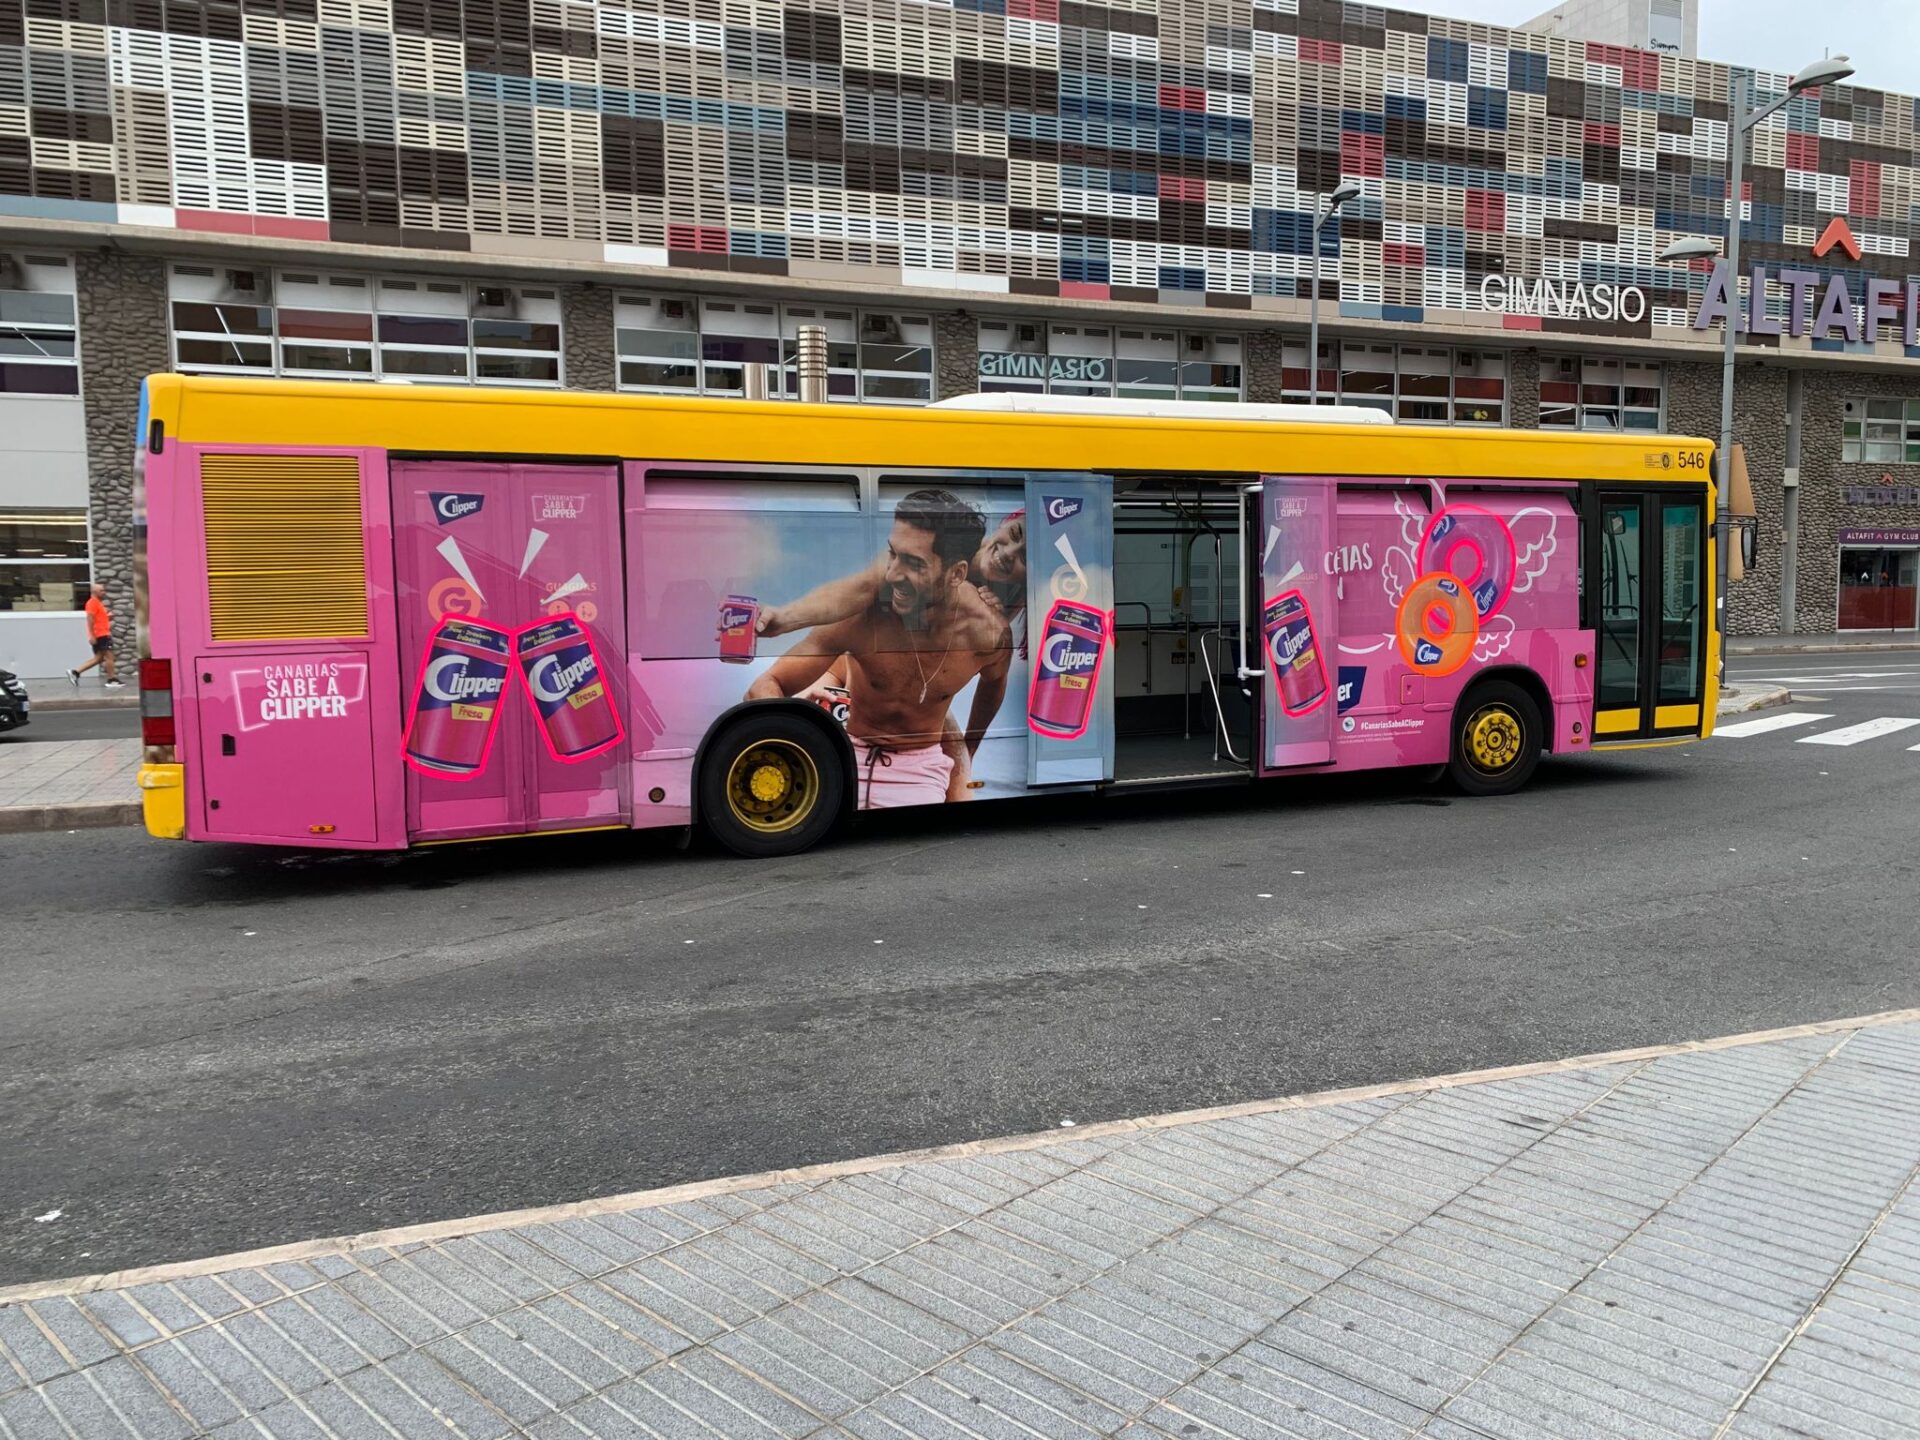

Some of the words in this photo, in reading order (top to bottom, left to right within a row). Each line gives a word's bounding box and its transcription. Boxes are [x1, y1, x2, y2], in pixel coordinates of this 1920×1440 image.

[1480, 274, 1646, 323] GIMNASIO
[979, 353, 1105, 381] GIMNASIO
[1678, 450, 1705, 470] 546
[438, 495, 479, 518] Clipper
[542, 509, 577, 519] CLIPPER
[1049, 498, 1079, 519] Clipper
[1846, 532, 1874, 540] ALTAFIT
[1042, 633, 1098, 673] Clipper
[1271, 625, 1311, 666] Clipper
[264, 663, 340, 680] CANARIAS
[423, 654, 506, 702] Clipper
[528, 654, 596, 702] Clipper
[266, 677, 317, 698] SABE
[326, 676, 339, 695] A
[574, 688, 598, 705] Fresa
[260, 695, 347, 721] CLIPPER
[458, 707, 483, 720] Fresa
